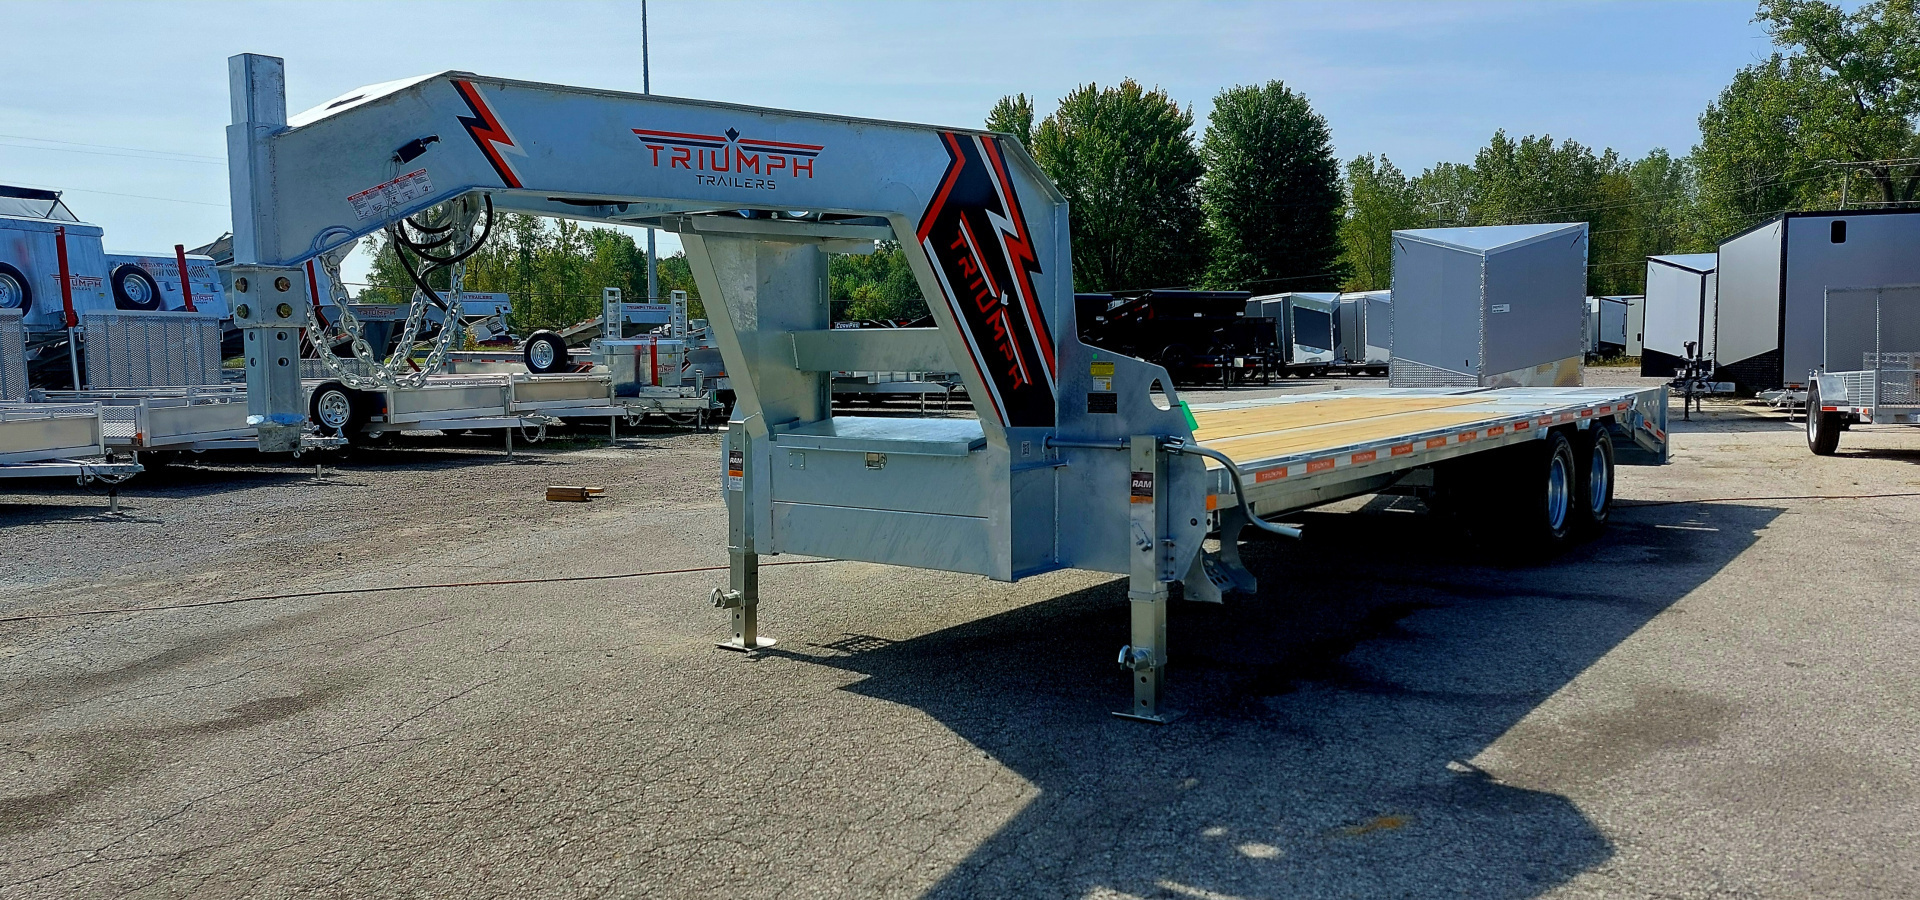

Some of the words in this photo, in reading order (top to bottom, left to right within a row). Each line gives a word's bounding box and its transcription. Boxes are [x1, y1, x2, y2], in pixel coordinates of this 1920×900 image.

[645, 144, 815, 179] TRIUMPH
[695, 174, 776, 190] TRAILERS
[54, 279, 101, 287] TUMPH
[950, 229, 1023, 390] TRIUMPH
[1261, 470, 1283, 479] TRIUMPH
[1132, 479, 1152, 489] RAM
